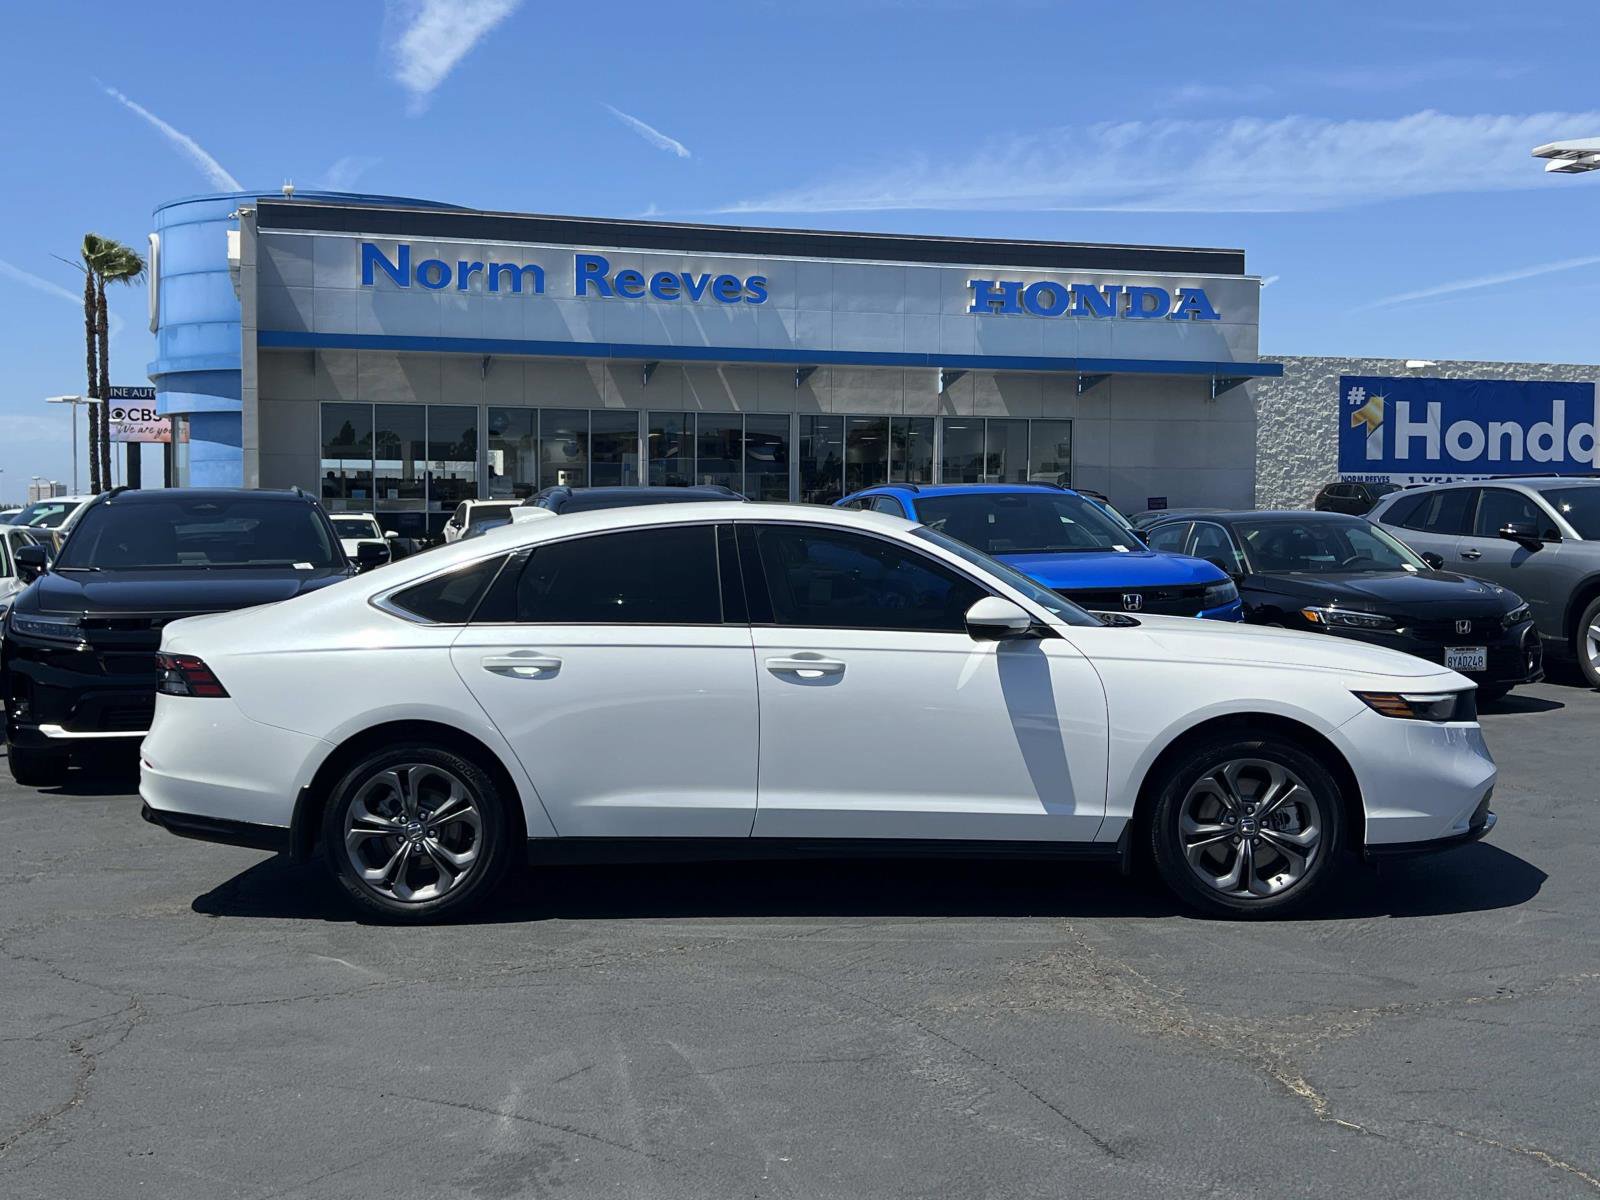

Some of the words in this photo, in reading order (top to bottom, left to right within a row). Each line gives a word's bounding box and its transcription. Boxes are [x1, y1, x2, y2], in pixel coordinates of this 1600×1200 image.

[360, 242, 546, 291] Norm
[573, 253, 769, 305] Reeves
[966, 279, 1222, 321] HONDA
[131, 387, 157, 397] AUT
[1341, 474, 1364, 483] NORM
[1365, 475, 1391, 484] REEVES
[1421, 476, 1465, 484] YEA
